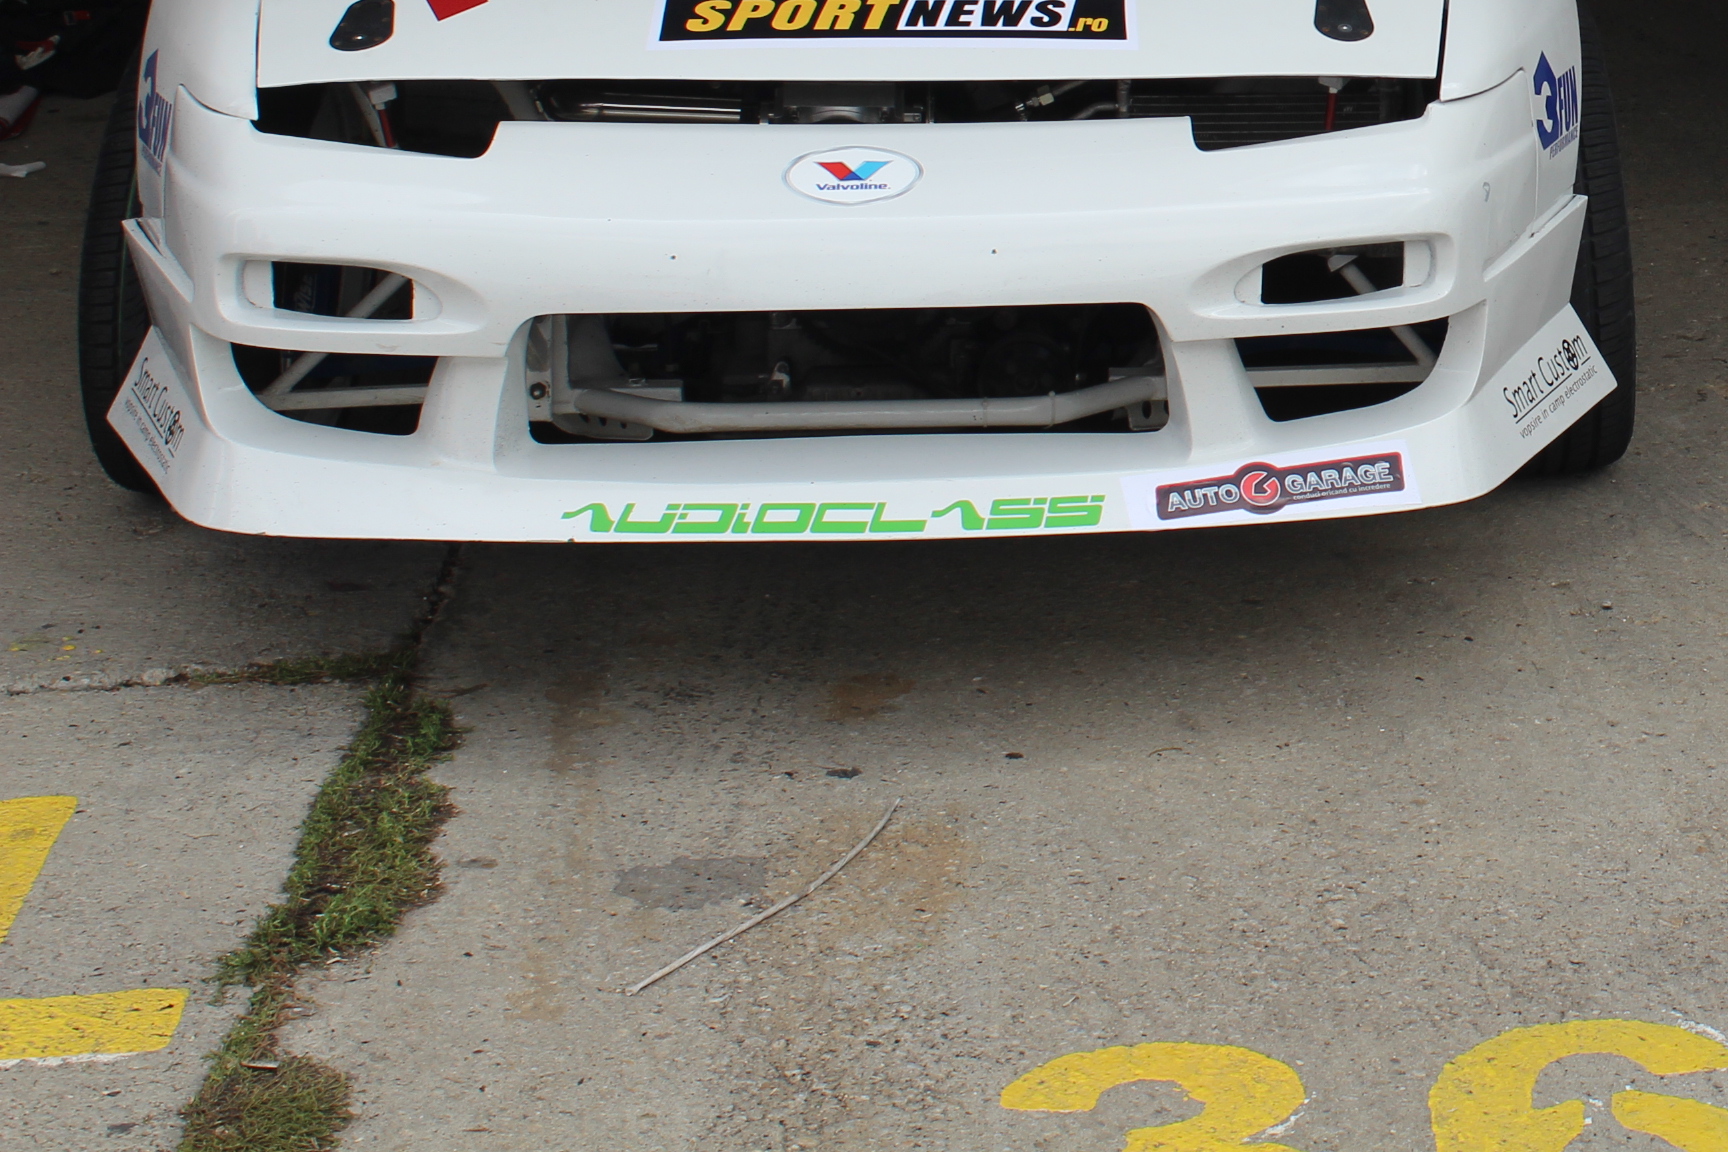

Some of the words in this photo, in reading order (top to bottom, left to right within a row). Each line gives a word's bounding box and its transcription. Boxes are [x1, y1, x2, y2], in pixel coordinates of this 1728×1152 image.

[815, 182, 890, 191] Valvoline
[1503, 370, 1545, 419] Smart
[1548, 395, 1566, 414] camp
[1564, 364, 1598, 400] electrostatic
[1167, 483, 1241, 513] AUTO
[1284, 461, 1394, 494] GARAGE
